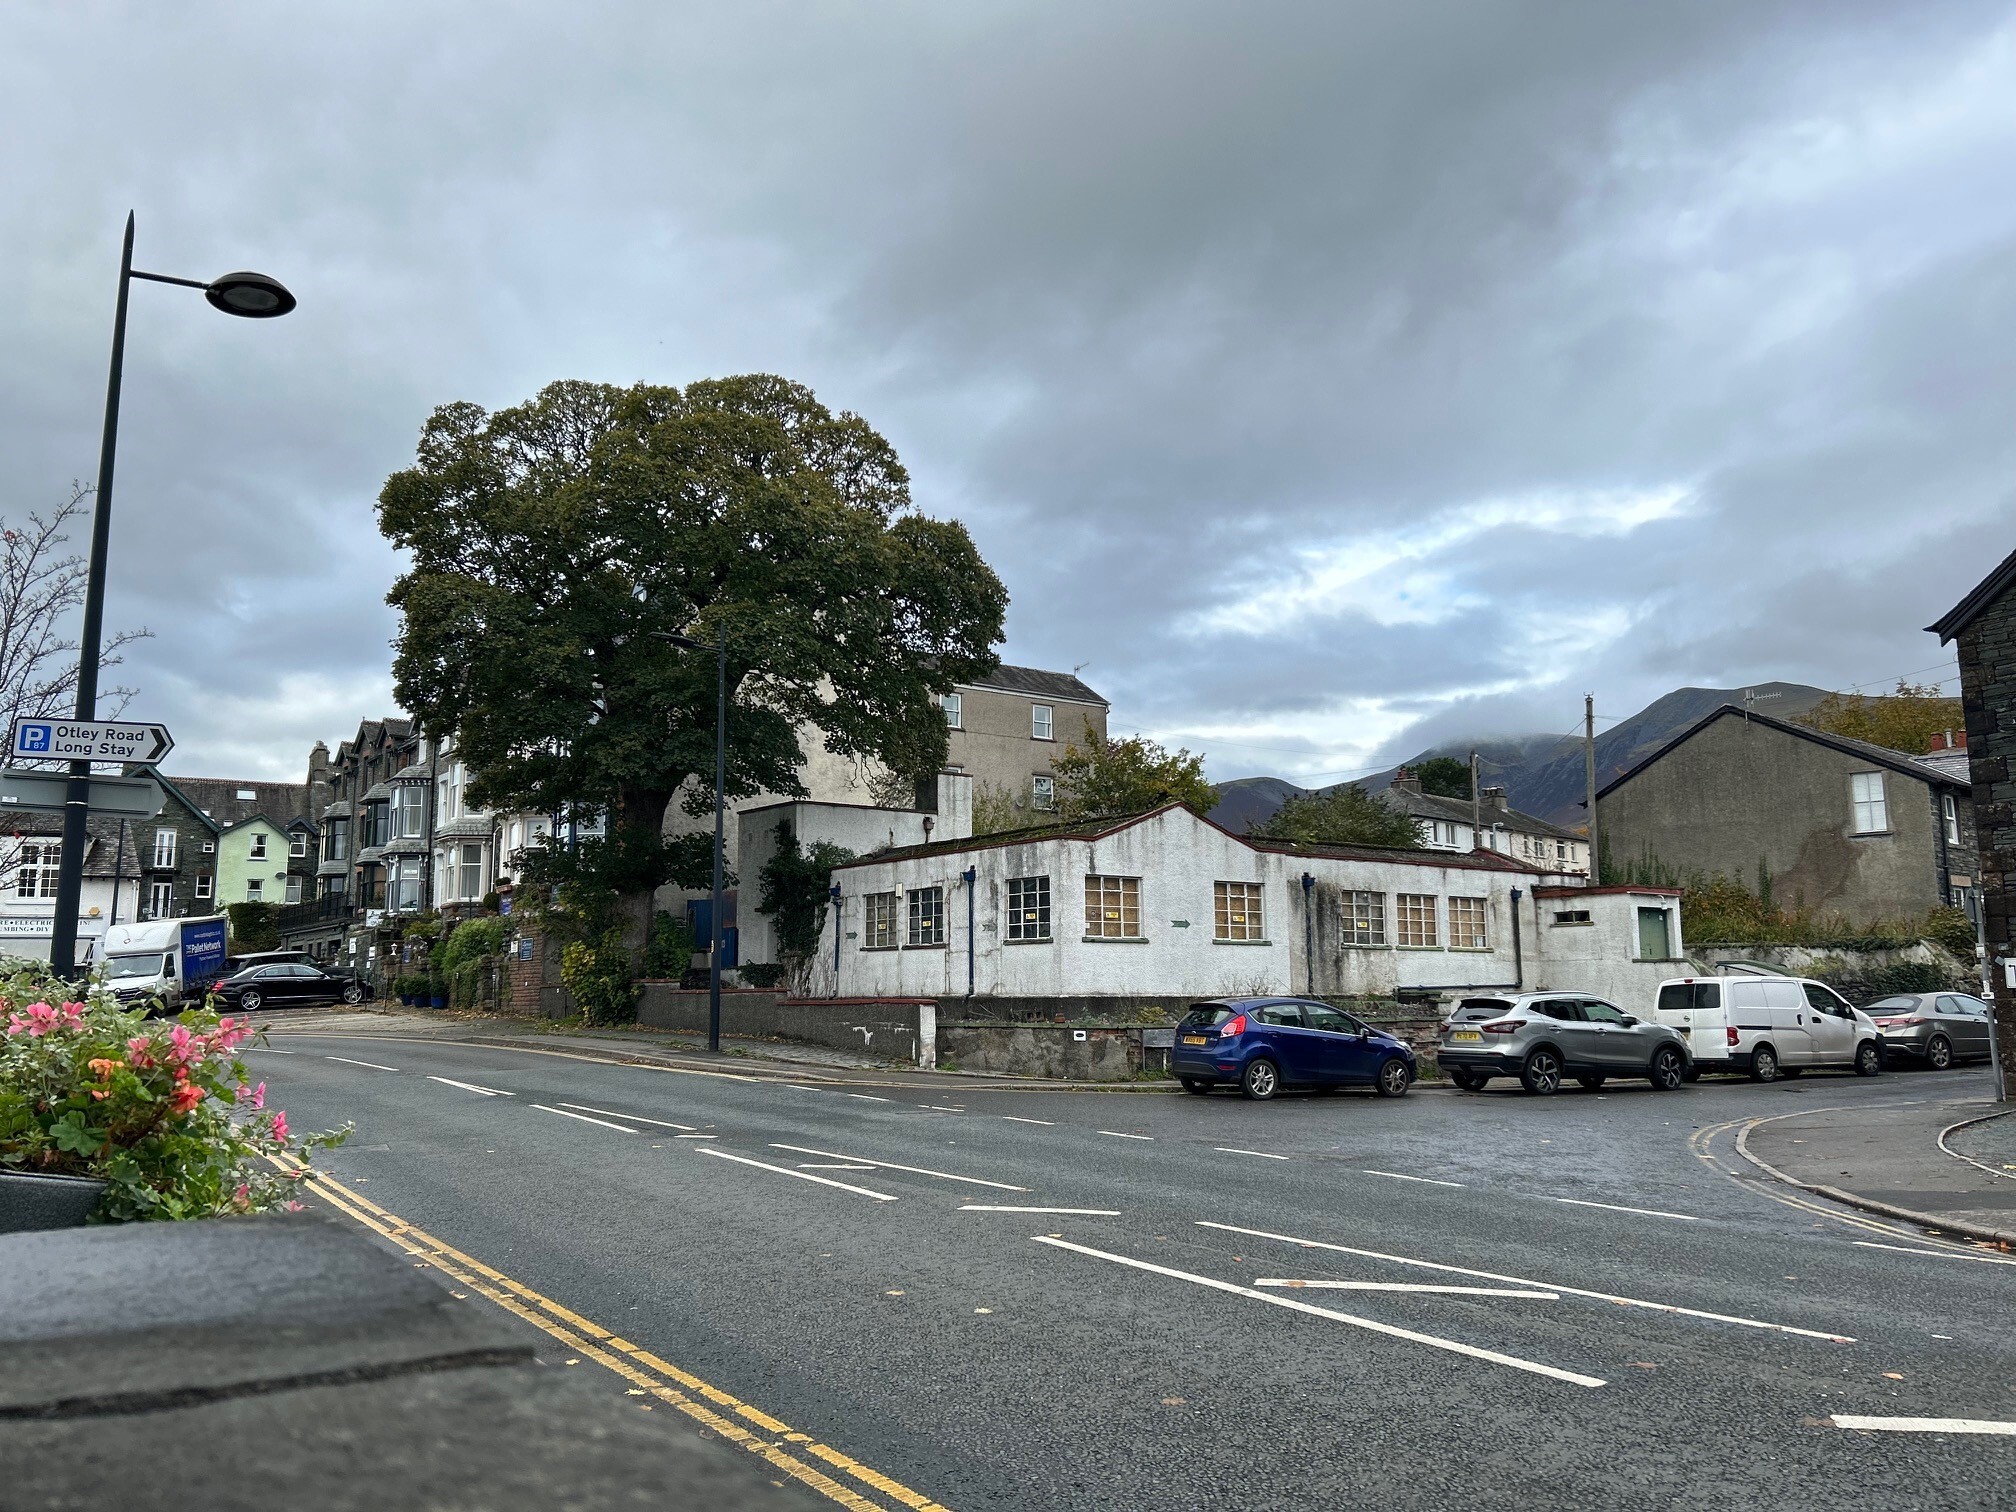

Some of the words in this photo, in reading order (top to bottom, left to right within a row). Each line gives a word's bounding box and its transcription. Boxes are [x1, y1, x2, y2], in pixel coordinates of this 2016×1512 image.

[24, 727, 44, 749] P
[57, 726, 98, 741] Otley
[105, 728, 144, 741] Road
[55, 741, 92, 755] Long
[98, 742, 135, 757] Stay
[191, 943, 203, 953] Pallet
[203, 940, 221, 951] Network
